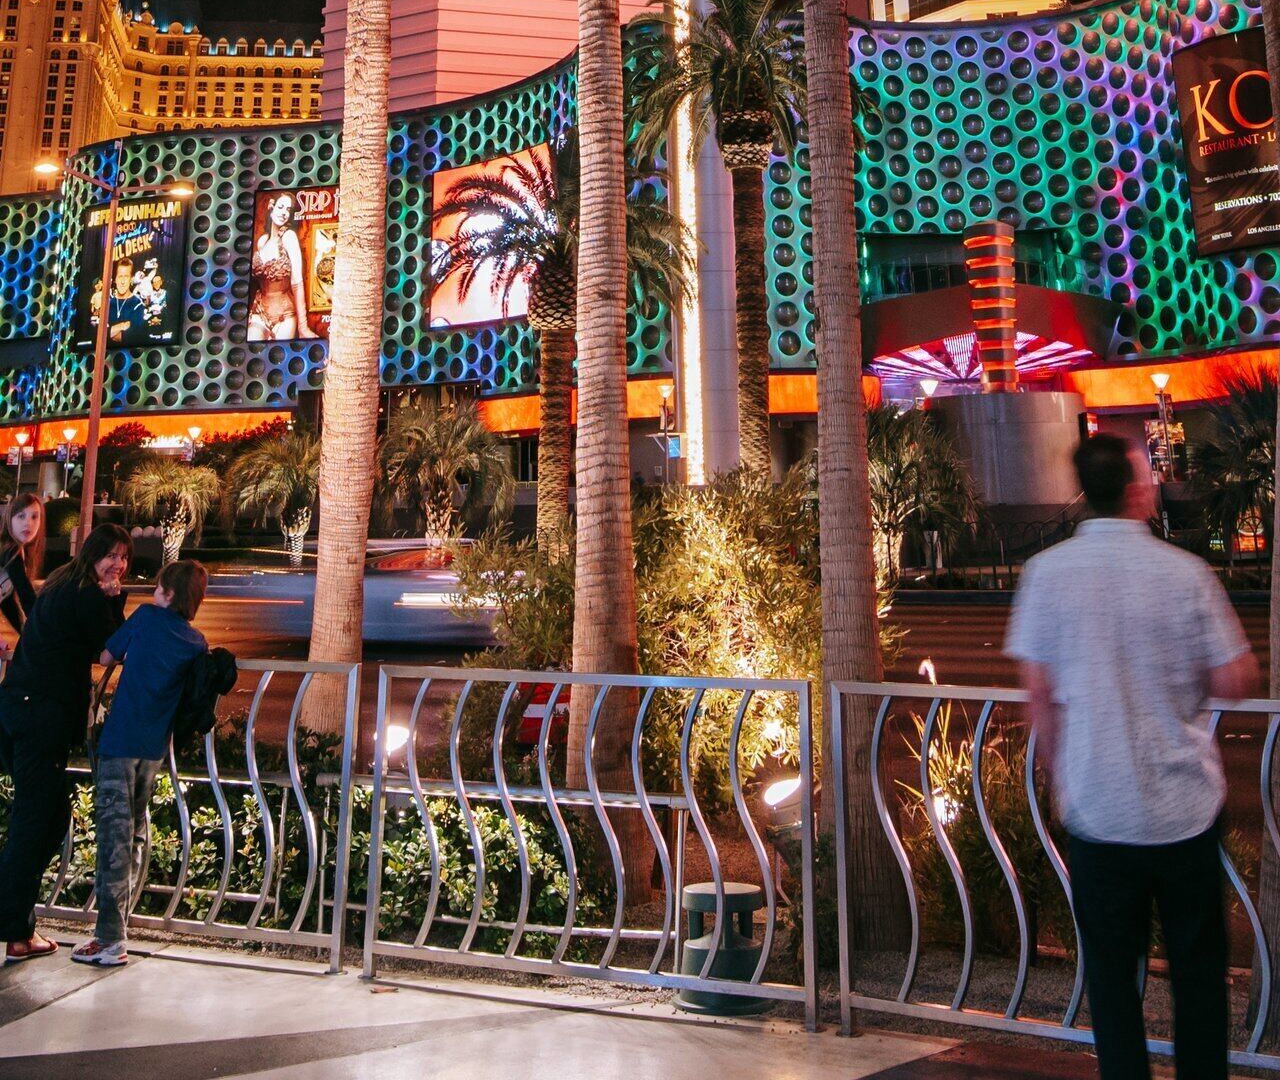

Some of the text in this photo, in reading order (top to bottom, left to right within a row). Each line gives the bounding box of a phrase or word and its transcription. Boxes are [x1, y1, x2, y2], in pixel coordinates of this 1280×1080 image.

[1199, 133, 1260, 157] RESTAURANT
[87, 200, 182, 228] JEFF DUNHAM
[294, 190, 332, 216] STRIP
[1214, 193, 1264, 211] RESERVATIONS
[125, 233, 152, 257] DECK
